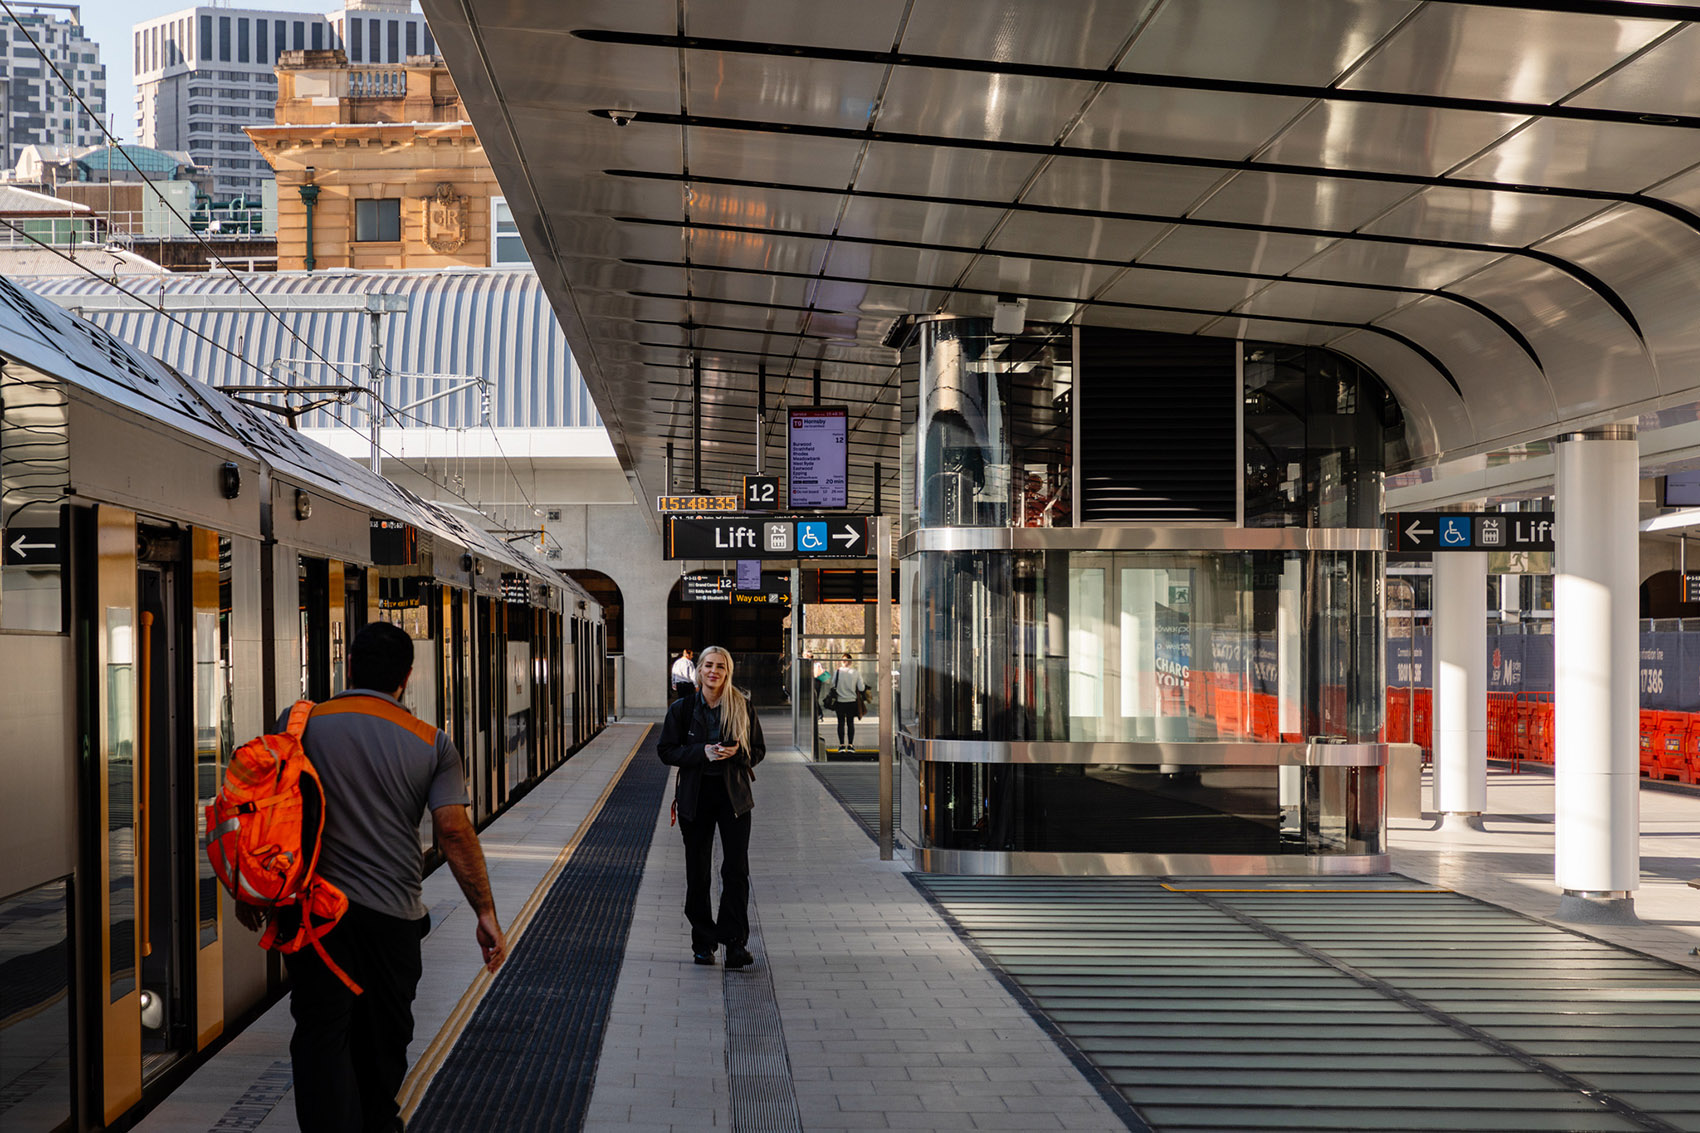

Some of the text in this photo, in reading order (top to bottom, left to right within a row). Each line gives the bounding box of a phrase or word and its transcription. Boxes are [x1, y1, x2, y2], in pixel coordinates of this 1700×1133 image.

[749, 484, 775, 502] 12
[660, 497, 736, 511] 15:48:35
[715, 527, 756, 548] Lift
[1515, 520, 1556, 542] Lift
[720, 580, 732, 588] 12
[736, 594, 752, 603] Way
[1156, 657, 1190, 678] CHARG
